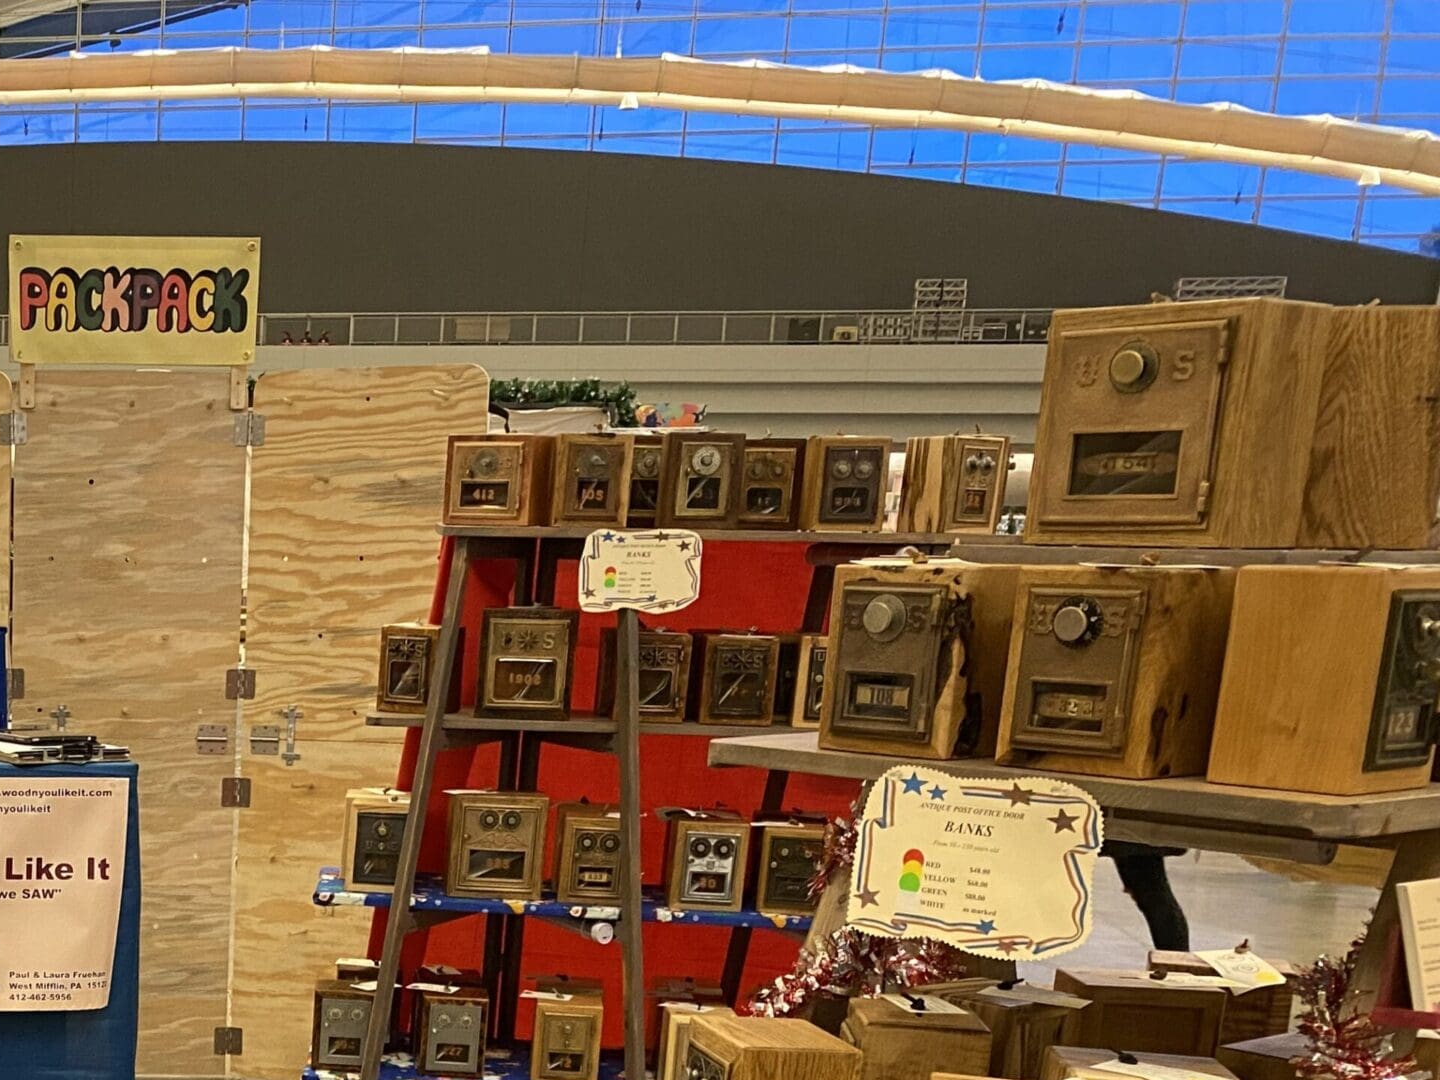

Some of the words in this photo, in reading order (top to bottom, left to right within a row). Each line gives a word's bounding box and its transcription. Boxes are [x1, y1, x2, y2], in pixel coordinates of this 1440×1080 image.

[20, 266, 250, 333] PACKPACK
[1171, 351, 1196, 381] S
[543, 631, 554, 649] S
[920, 802, 952, 813] ANTIQUE
[953, 805, 973, 815] POST
[972, 808, 1002, 818] OFFICE
[1003, 811, 1025, 820] DOOR
[944, 821, 994, 837] BANKS
[5, 857, 74, 881] Like
[87, 857, 110, 881] It
[926, 861, 941, 869] RED
[924, 874, 956, 884] YELLOW
[22, 889, 62, 899] SAW"
[921, 887, 948, 896] GREEN
[920, 899, 944, 909] WHITE
